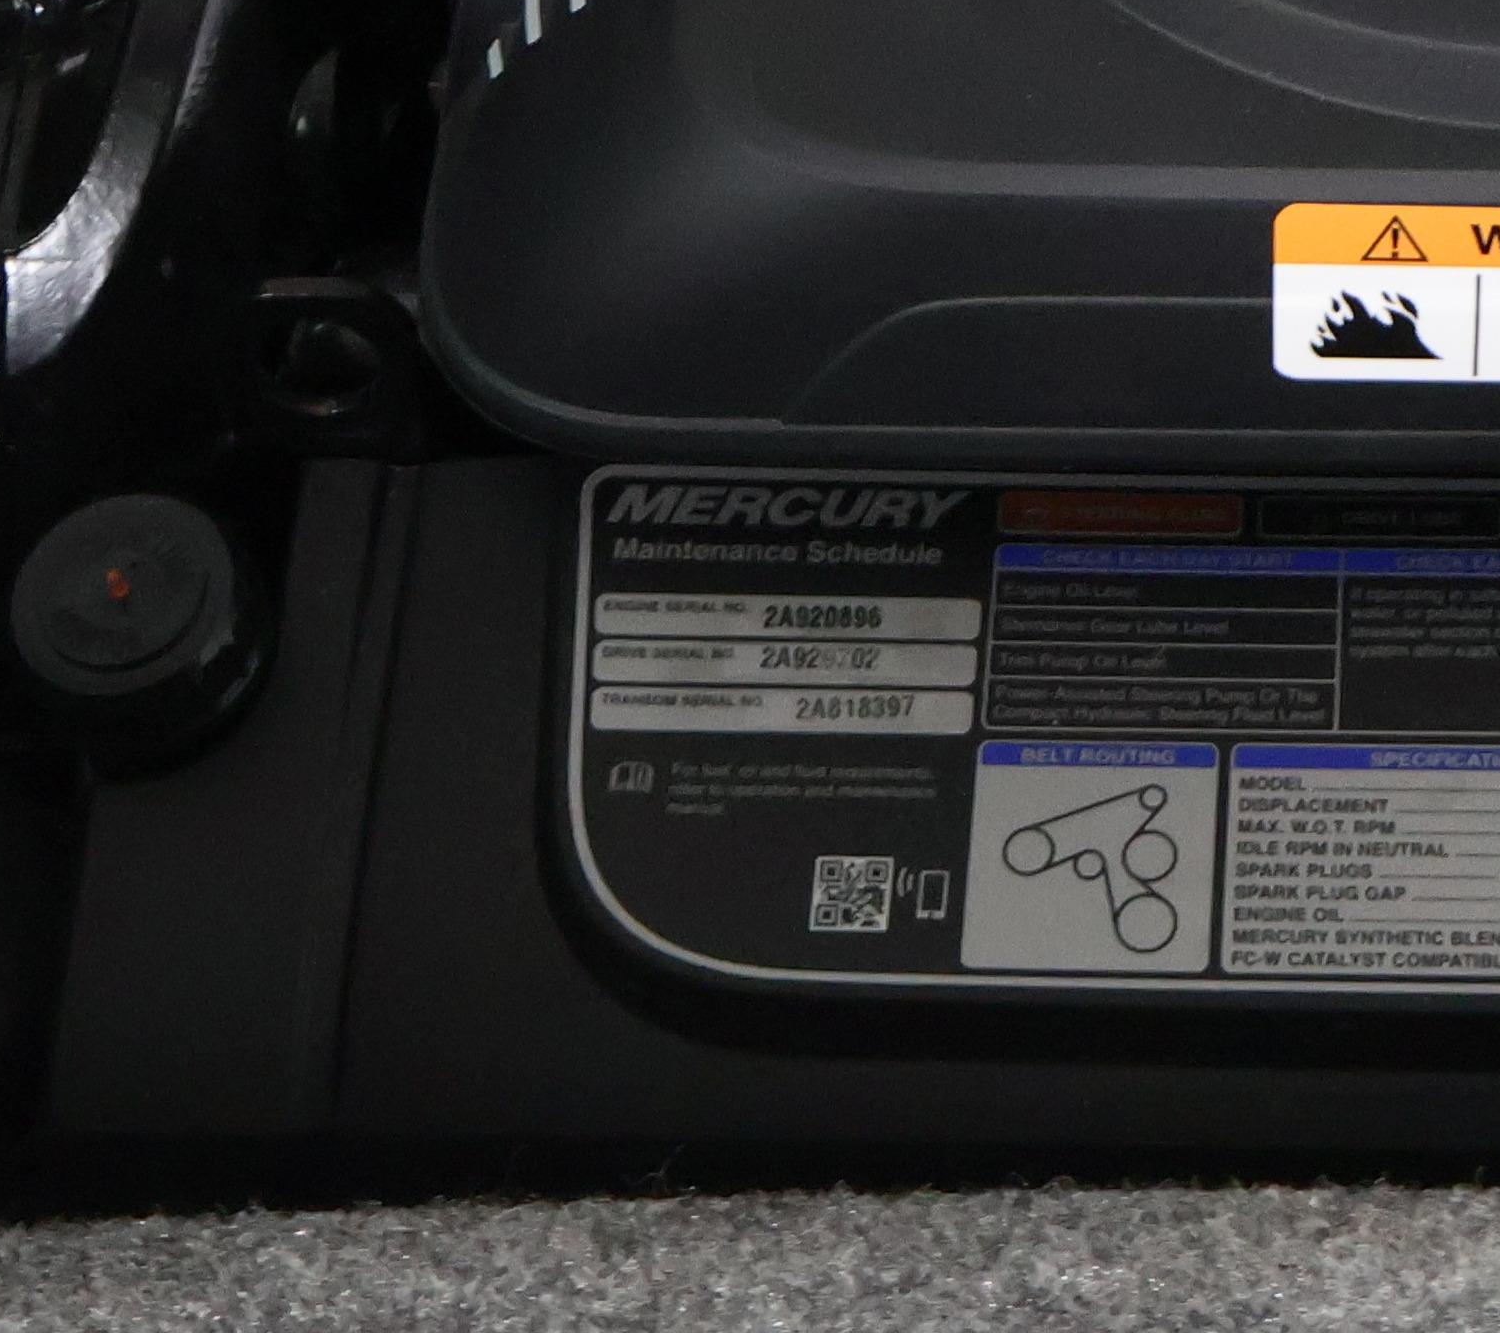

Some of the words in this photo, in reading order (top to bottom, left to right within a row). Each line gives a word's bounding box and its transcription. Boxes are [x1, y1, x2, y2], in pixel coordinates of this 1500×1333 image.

[606, 486, 968, 526] MERCURY
[612, 539, 798, 561] Maintenance
[807, 542, 943, 564] Schedule
[1021, 748, 1073, 767] BELT
[1079, 748, 1175, 768] ROUTING
[1235, 841, 1279, 856] IDLE
[1285, 841, 1328, 856] RPM
[1333, 842, 1353, 856] IN
[1357, 842, 1446, 857] NEUTRAL
[1234, 862, 1300, 878] SPARK
[1306, 863, 1373, 879] PLUGS
[1233, 884, 1299, 900] SPARK
[1306, 886, 1359, 901] PLUG
[1365, 886, 1406, 901] GAP
[1233, 907, 1306, 922] ENGINE
[1312, 907, 1344, 923] OIL
[1232, 929, 1329, 945] MERCURY
[1335, 930, 1444, 946] SYNTHETIC
[1231, 951, 1282, 970] FC-W
[1287, 952, 1387, 970] CATALYST
